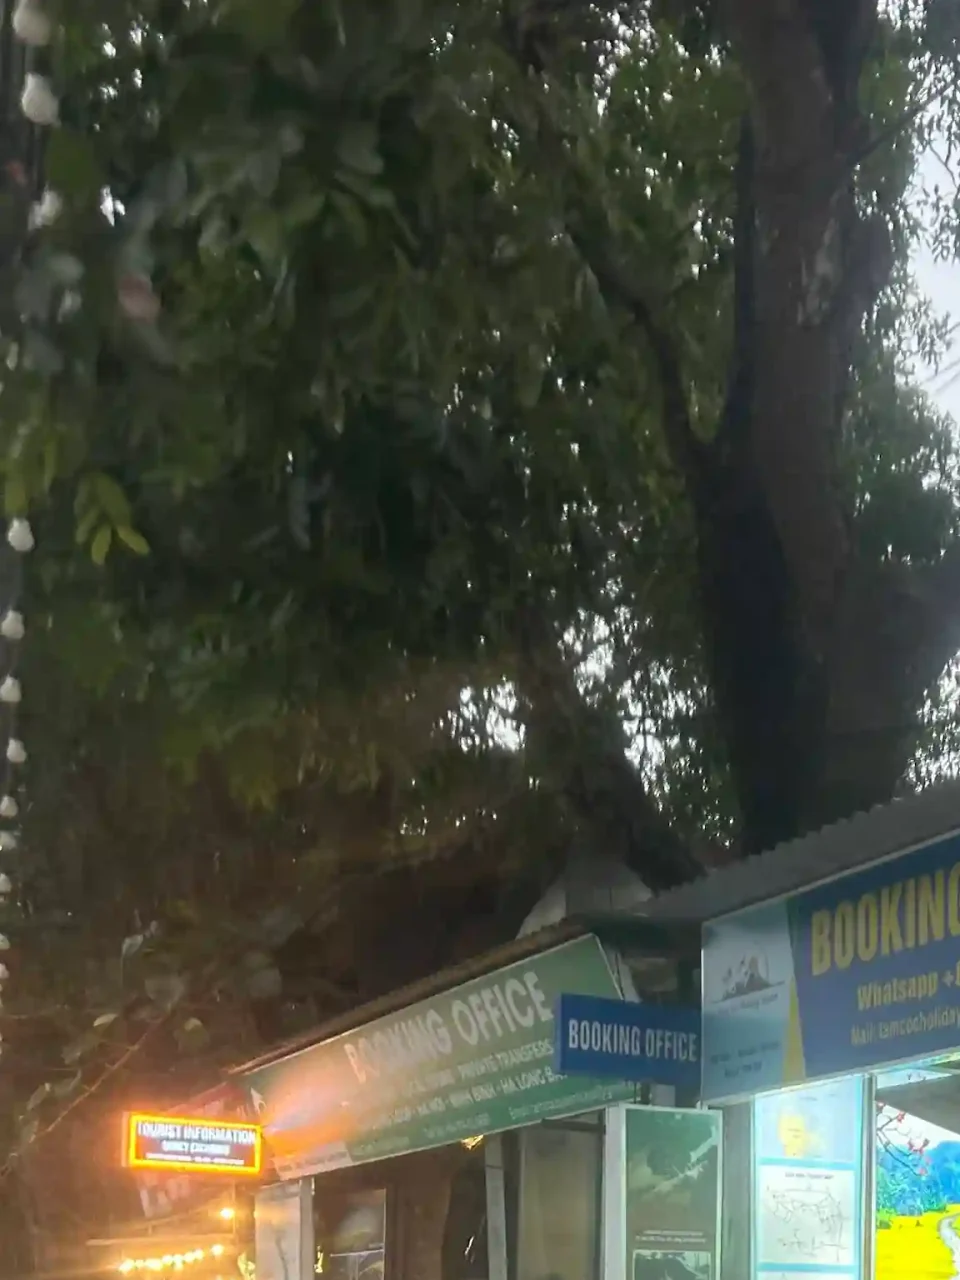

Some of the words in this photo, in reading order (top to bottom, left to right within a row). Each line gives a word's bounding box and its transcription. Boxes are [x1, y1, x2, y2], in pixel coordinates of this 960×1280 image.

[858, 971, 938, 1011] Whatsapp
[344, 1008, 453, 1085] BOOKING
[451, 971, 554, 1046] OFFICE
[568, 1018, 641, 1056] BOOKING
[645, 1028, 698, 1062] OFFICE
[183, 1124, 256, 1145] INFORMATION
